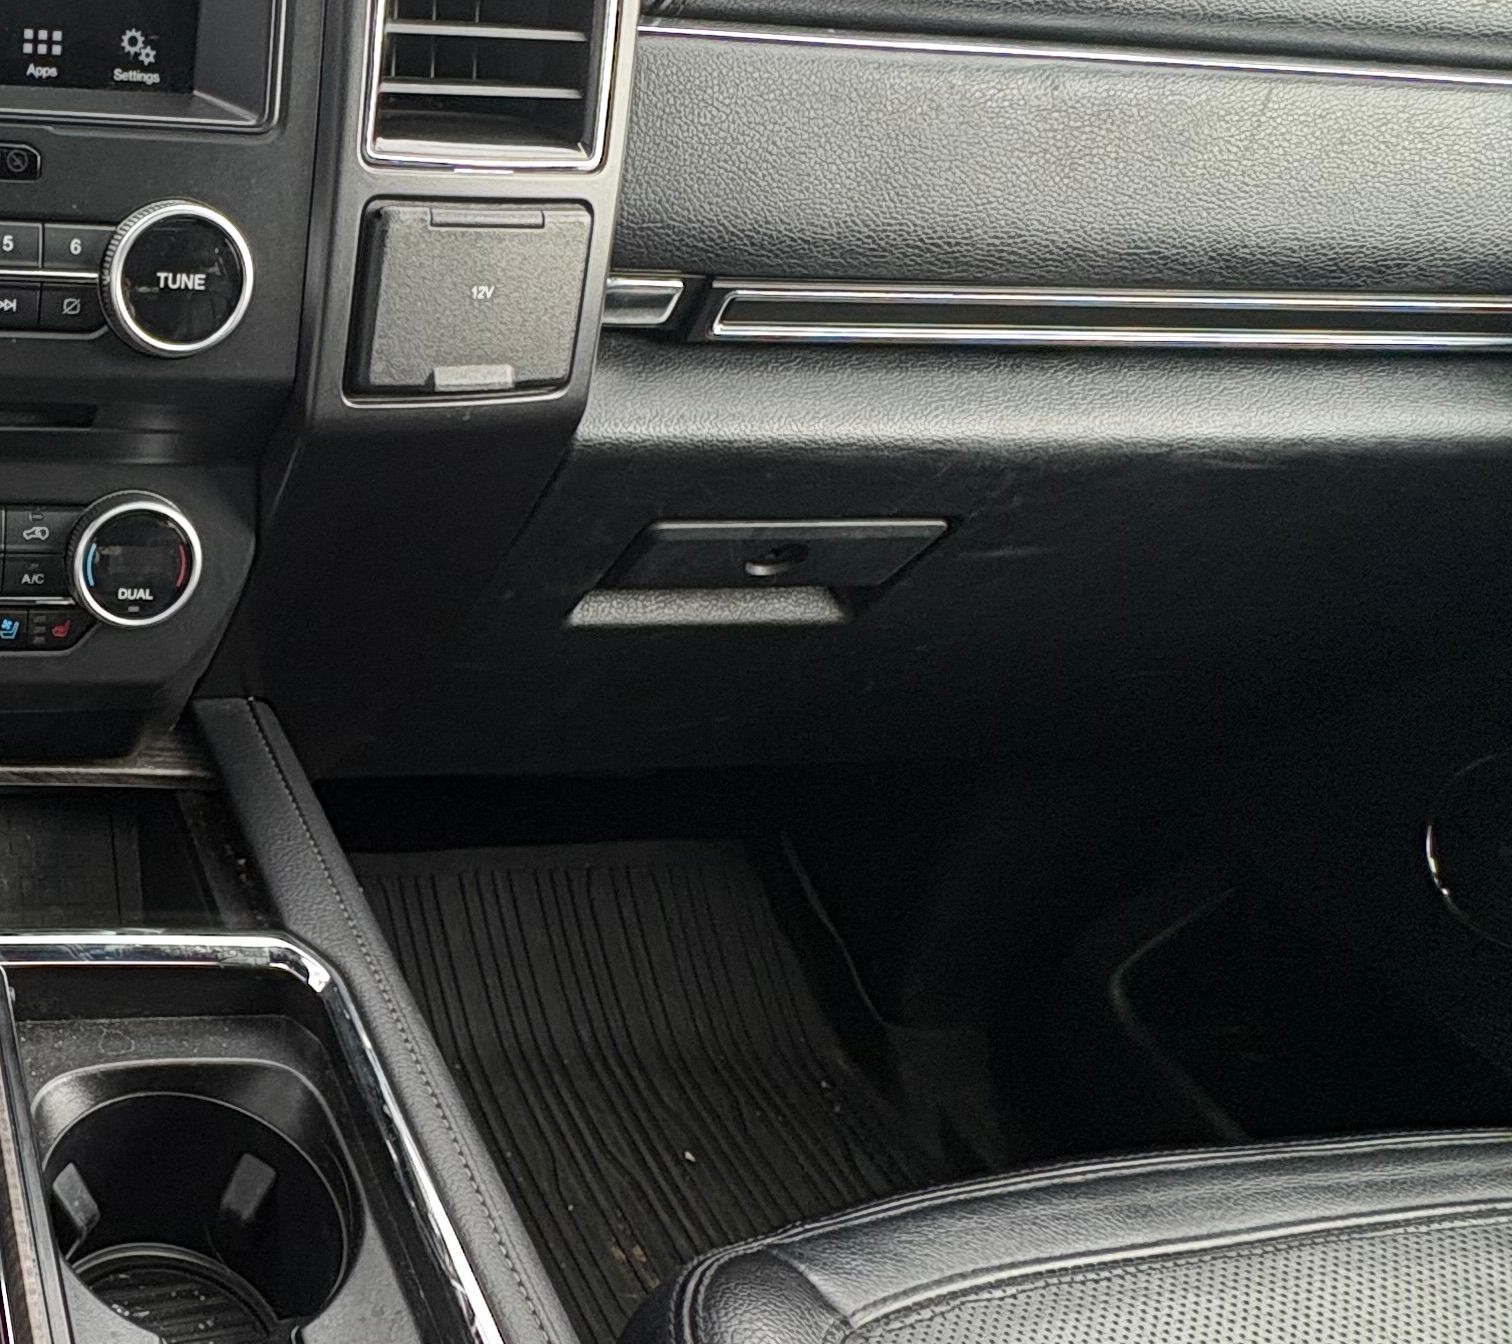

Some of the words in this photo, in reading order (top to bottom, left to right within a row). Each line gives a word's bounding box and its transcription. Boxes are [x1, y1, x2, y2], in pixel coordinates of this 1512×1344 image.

[26, 63, 58, 79] Apps
[113, 68, 160, 85] Settings
[2, 235, 14, 252] 5
[70, 238, 81, 255] 6
[157, 272, 206, 291] TUNE
[471, 285, 495, 299] 12V
[21, 573, 44, 585] A/C
[118, 587, 154, 601] DUAL
